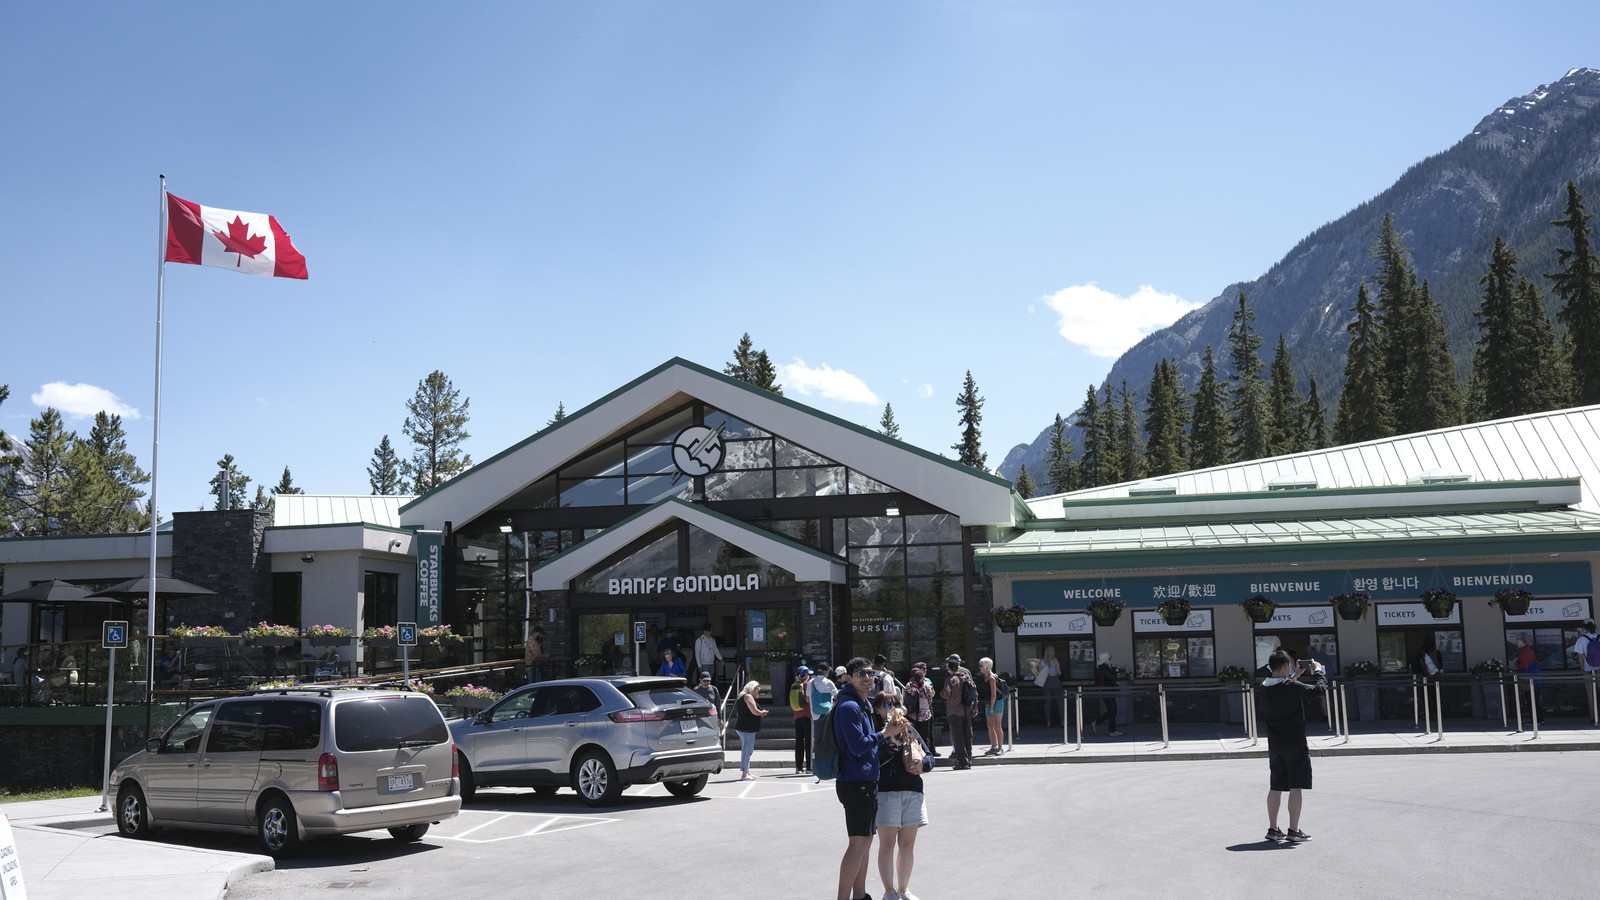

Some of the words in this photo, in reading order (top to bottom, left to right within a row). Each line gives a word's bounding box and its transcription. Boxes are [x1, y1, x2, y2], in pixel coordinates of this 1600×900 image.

[420, 559, 428, 607] COFFEE
[429, 544, 438, 622] STARBUCKS
[608, 577, 667, 595] BANFF
[673, 573, 760, 593] GONDOLA
[1250, 581, 1321, 593] BIENVENUE
[1453, 574, 1534, 587] BIENVENIDO
[1063, 587, 1121, 599] WELCOME
[1023, 621, 1053, 629] TICKETS
